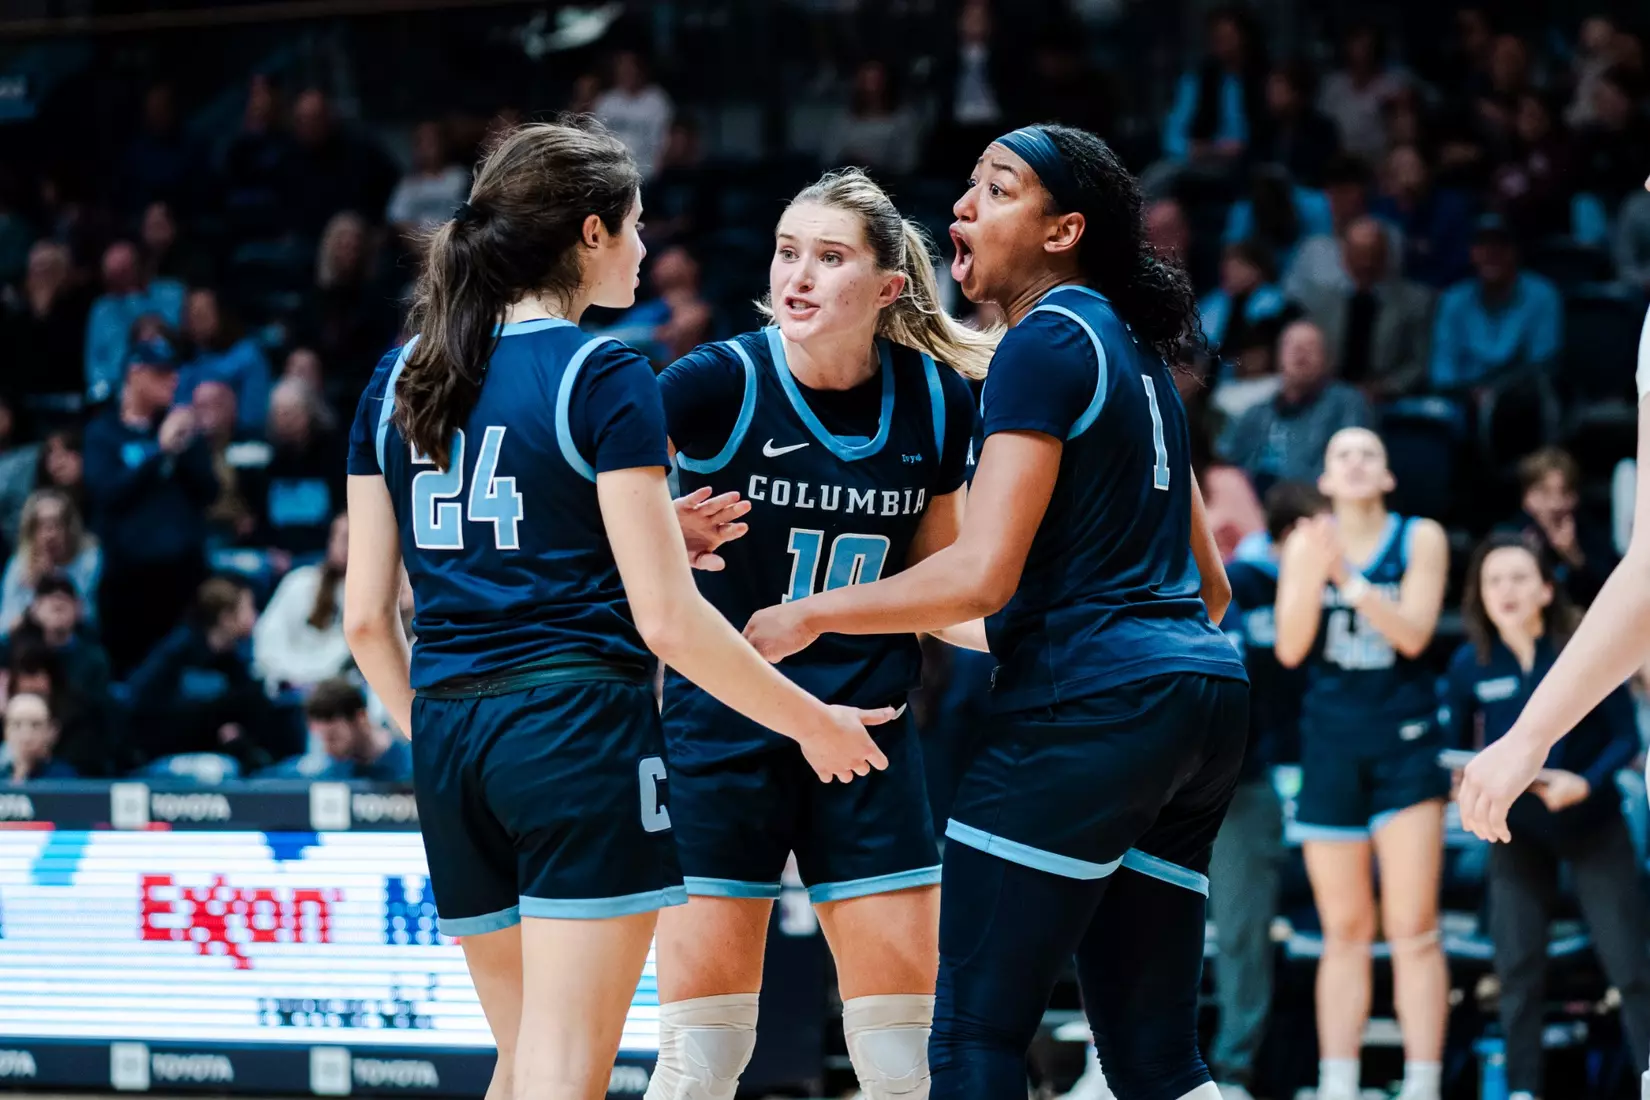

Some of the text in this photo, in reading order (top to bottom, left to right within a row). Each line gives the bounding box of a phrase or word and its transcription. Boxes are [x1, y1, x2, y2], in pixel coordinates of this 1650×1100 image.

[1141, 374, 1170, 491] 1
[411, 426, 524, 550] 24
[748, 474, 926, 516] COLUMBIA
[782, 527, 891, 602] 10
[152, 793, 231, 821] TOYOTA
[352, 793, 419, 822] TOYOT
[638, 756, 672, 833] C
[152, 1053, 234, 1082] TOYOTA
[353, 1058, 440, 1088] TOYOTA
